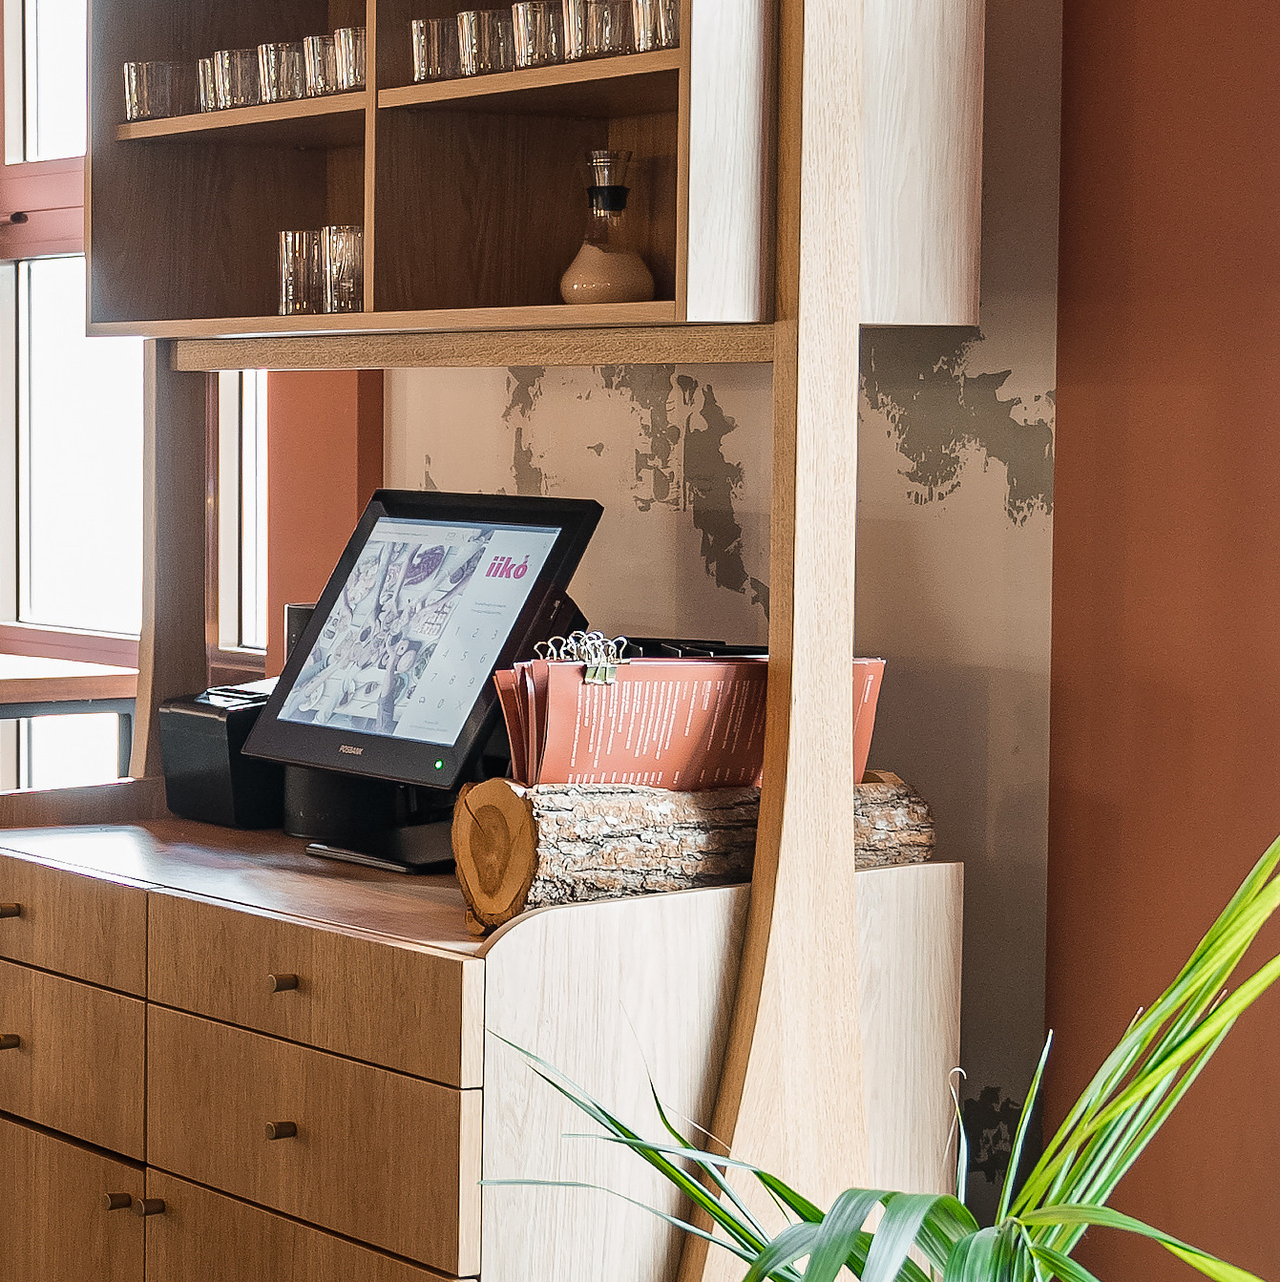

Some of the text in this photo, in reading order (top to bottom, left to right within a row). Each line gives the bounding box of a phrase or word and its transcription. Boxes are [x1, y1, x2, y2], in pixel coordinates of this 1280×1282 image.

[485, 553, 530, 579] iiko
[454, 625, 499, 640] 1 2 3
[442, 649, 488, 664] 4 5 6
[430, 672, 476, 688] 7 8 9
[437, 698, 445, 709] 0
